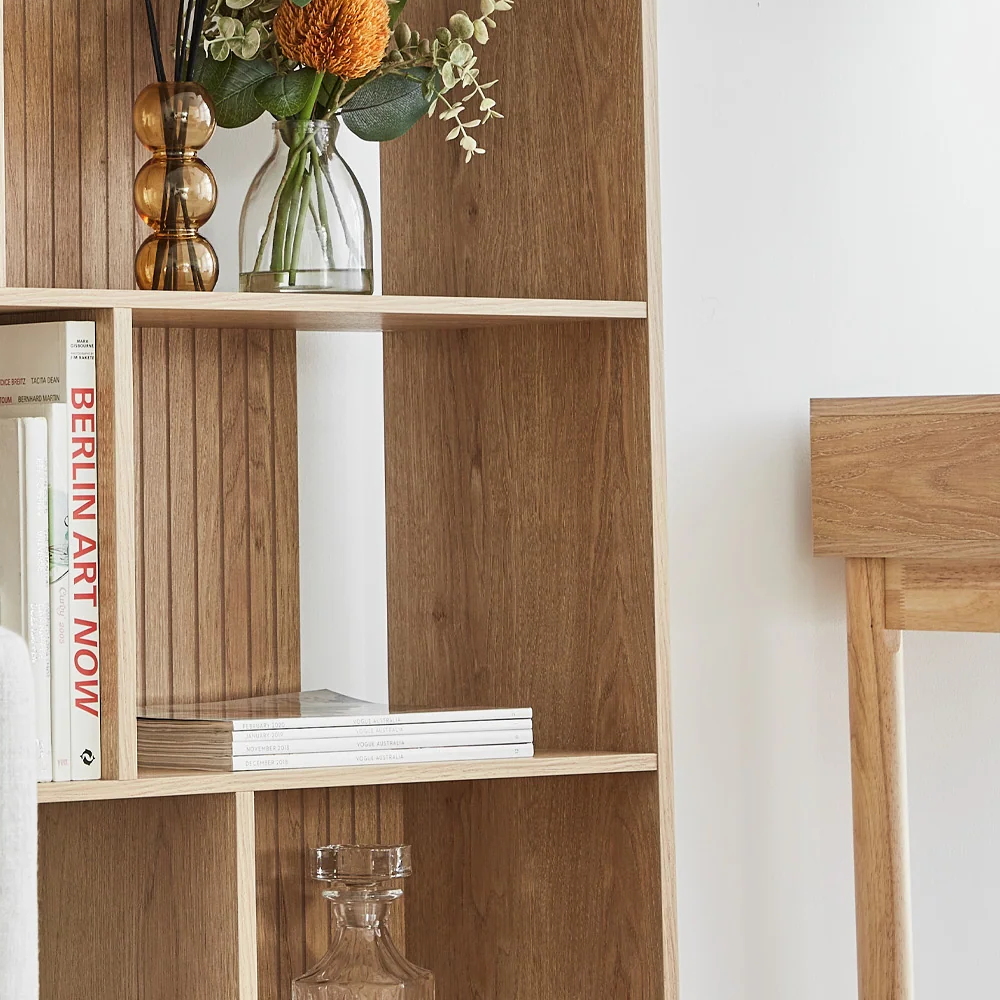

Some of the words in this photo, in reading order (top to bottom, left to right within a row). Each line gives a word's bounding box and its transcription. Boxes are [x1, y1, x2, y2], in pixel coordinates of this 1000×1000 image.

[18, 395, 42, 403] BERNHARD
[42, 394, 60, 402] MARTIN
[71, 387, 96, 521] BERLIN
[73, 531, 97, 607] ART
[74, 617, 99, 717] NOW
